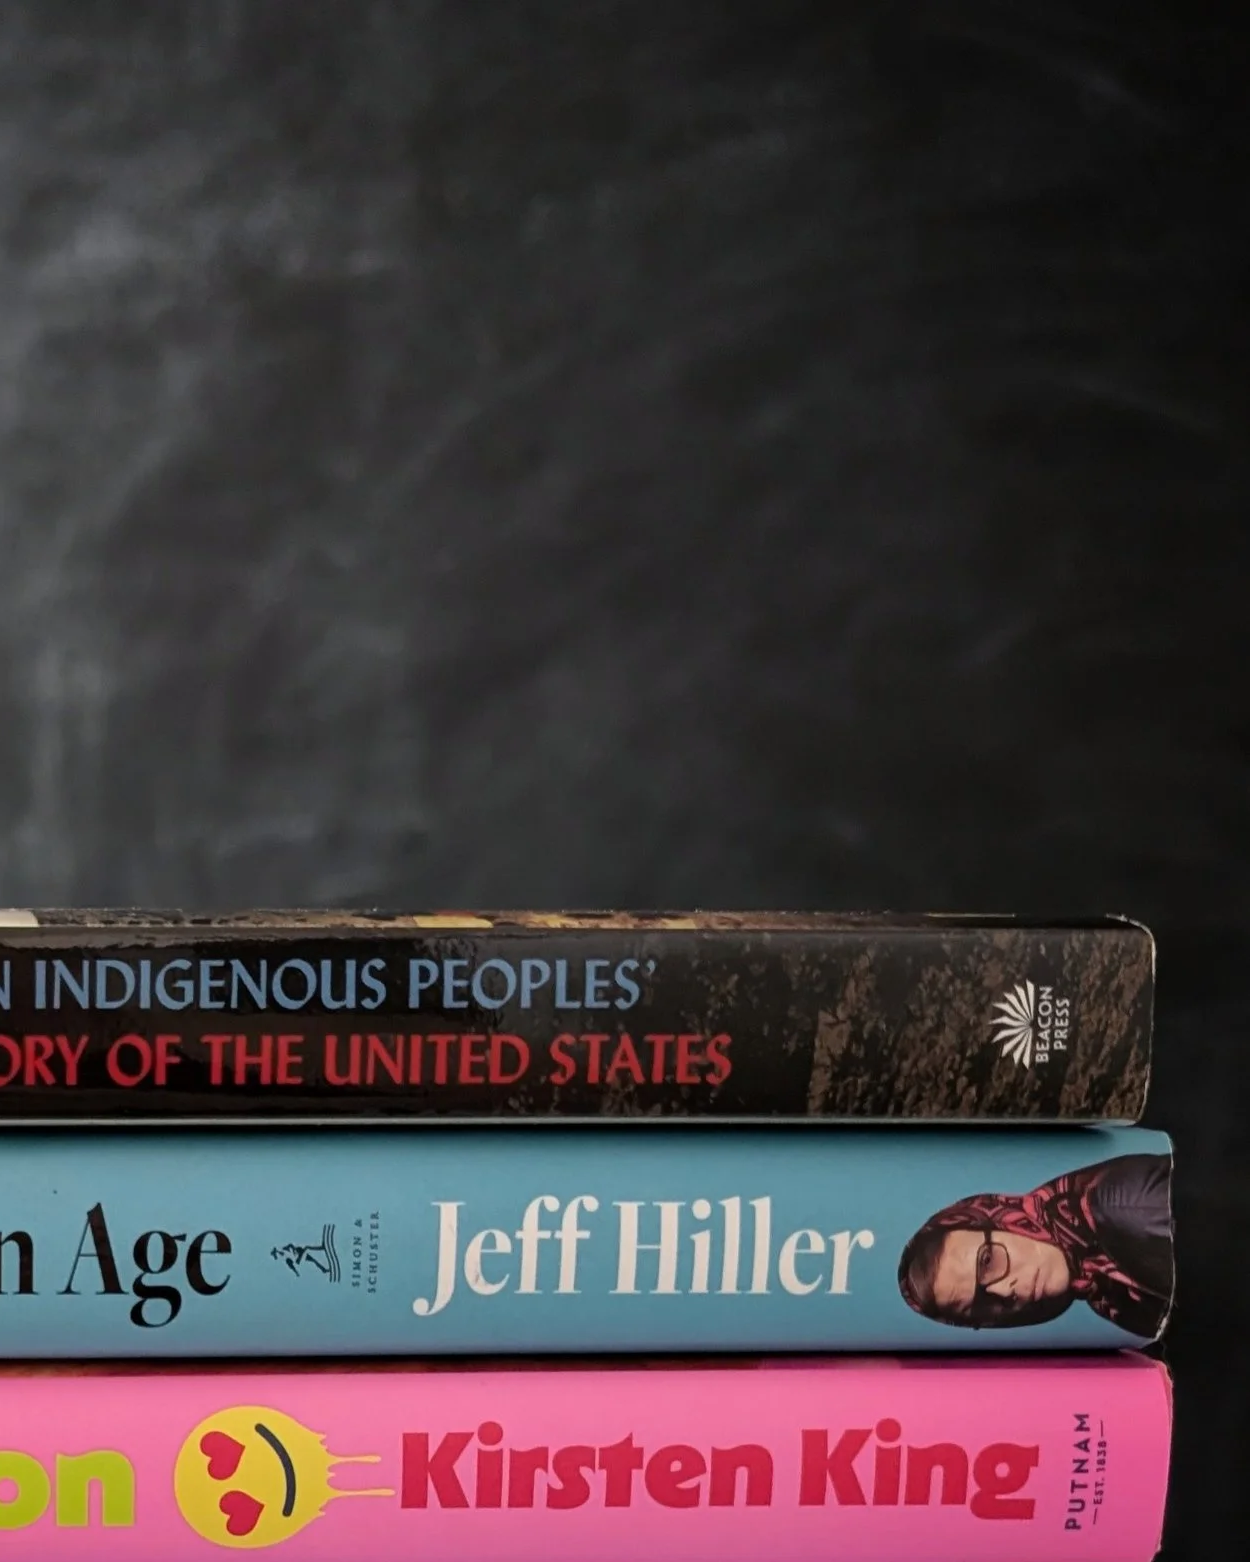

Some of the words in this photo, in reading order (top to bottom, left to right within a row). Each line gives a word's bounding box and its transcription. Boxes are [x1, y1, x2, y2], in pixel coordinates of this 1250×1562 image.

[34, 958, 387, 1011] INDIGENOUS
[407, 957, 656, 1010] PEOPLES'
[106, 1033, 181, 1086] OF
[200, 1033, 304, 1085] THE
[324, 1033, 530, 1086] UNITED
[549, 1032, 733, 1086] STATES
[1034, 986, 1053, 1063] BEACON
[1053, 998, 1070, 1051] PRESS
[56, 1201, 232, 1328] Age
[352, 1236, 362, 1287] SIMON
[368, 1211, 379, 1293] SCHUSTER
[412, 1195, 598, 1316] Jeff
[608, 1195, 874, 1296] Hiller
[400, 1420, 774, 1510] Kirsten
[798, 1417, 1040, 1521] King
[1064, 1413, 1091, 1531] PUTNAM
[1096, 1440, 1107, 1472] 1838
